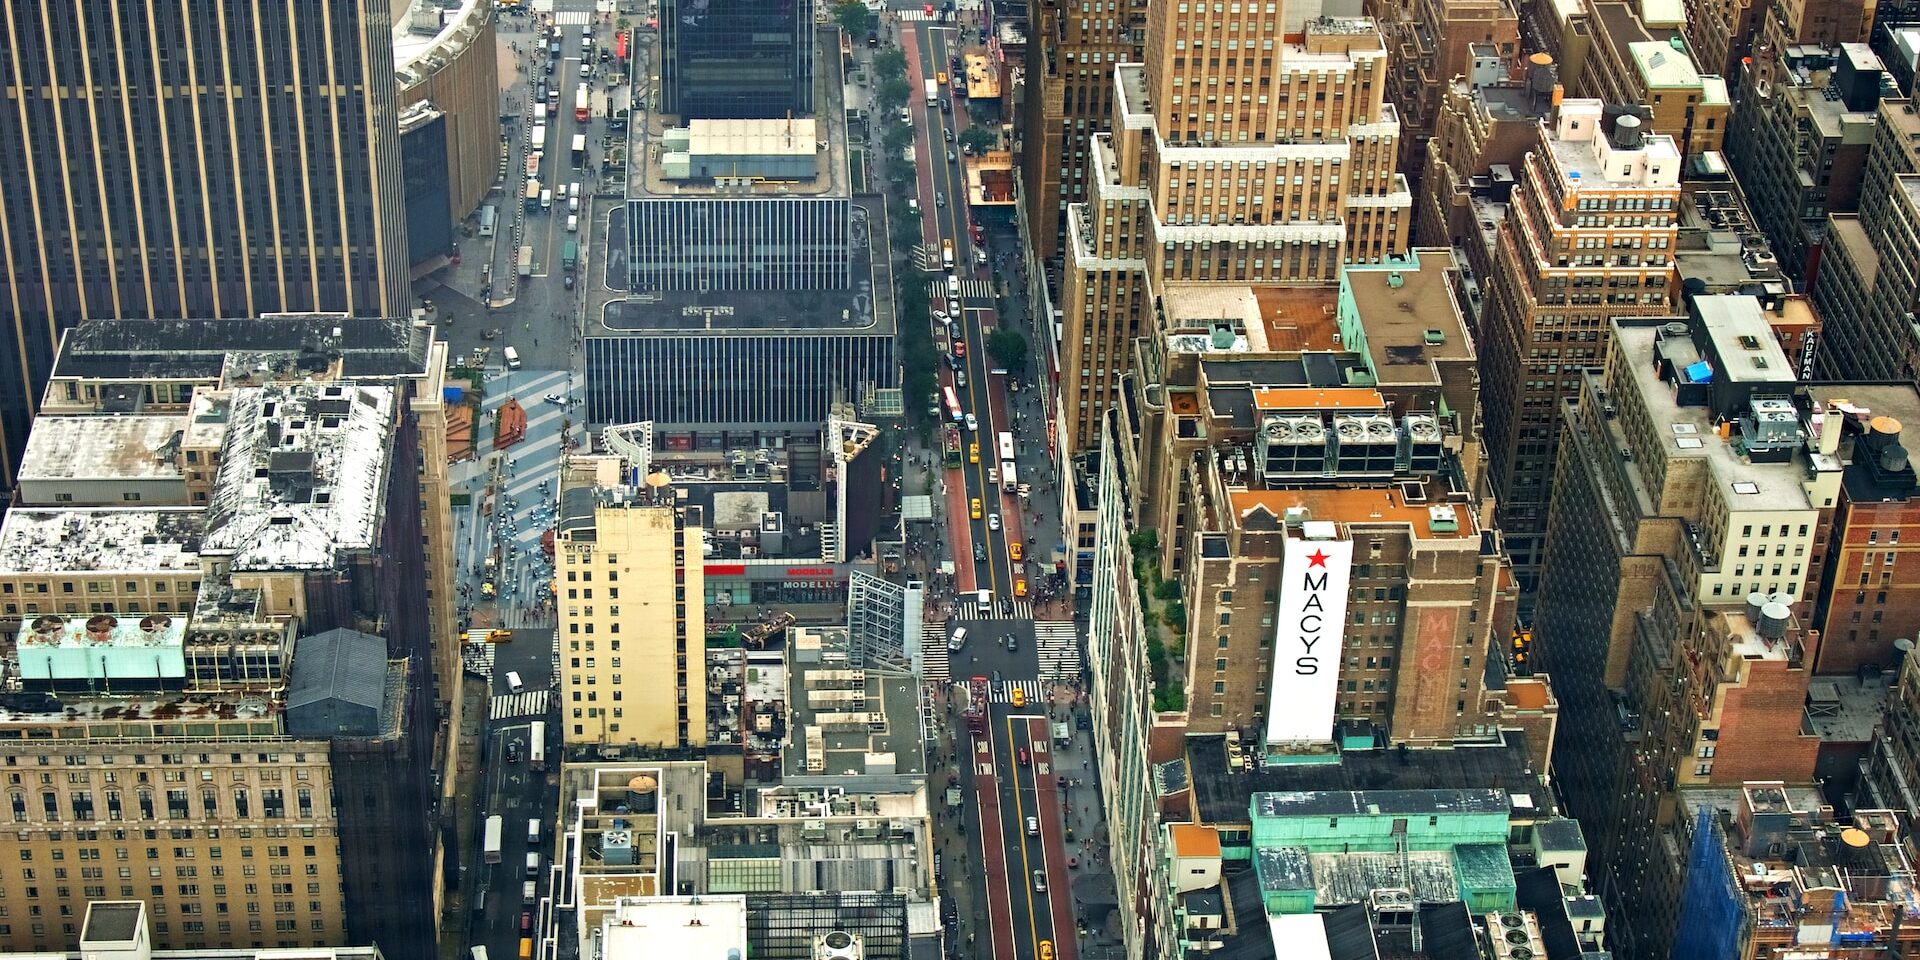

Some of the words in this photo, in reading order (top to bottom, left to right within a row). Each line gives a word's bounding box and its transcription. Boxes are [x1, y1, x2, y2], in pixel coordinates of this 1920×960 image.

[1802, 331, 1814, 379] KAUFMAN
[1013, 563, 1025, 574] BUS
[1295, 572, 1328, 675] MACYS
[977, 741, 989, 753] BUS
[1033, 740, 1048, 753] ONLY
[977, 763, 993, 776] ONLY
[1037, 762, 1050, 775] BUS
